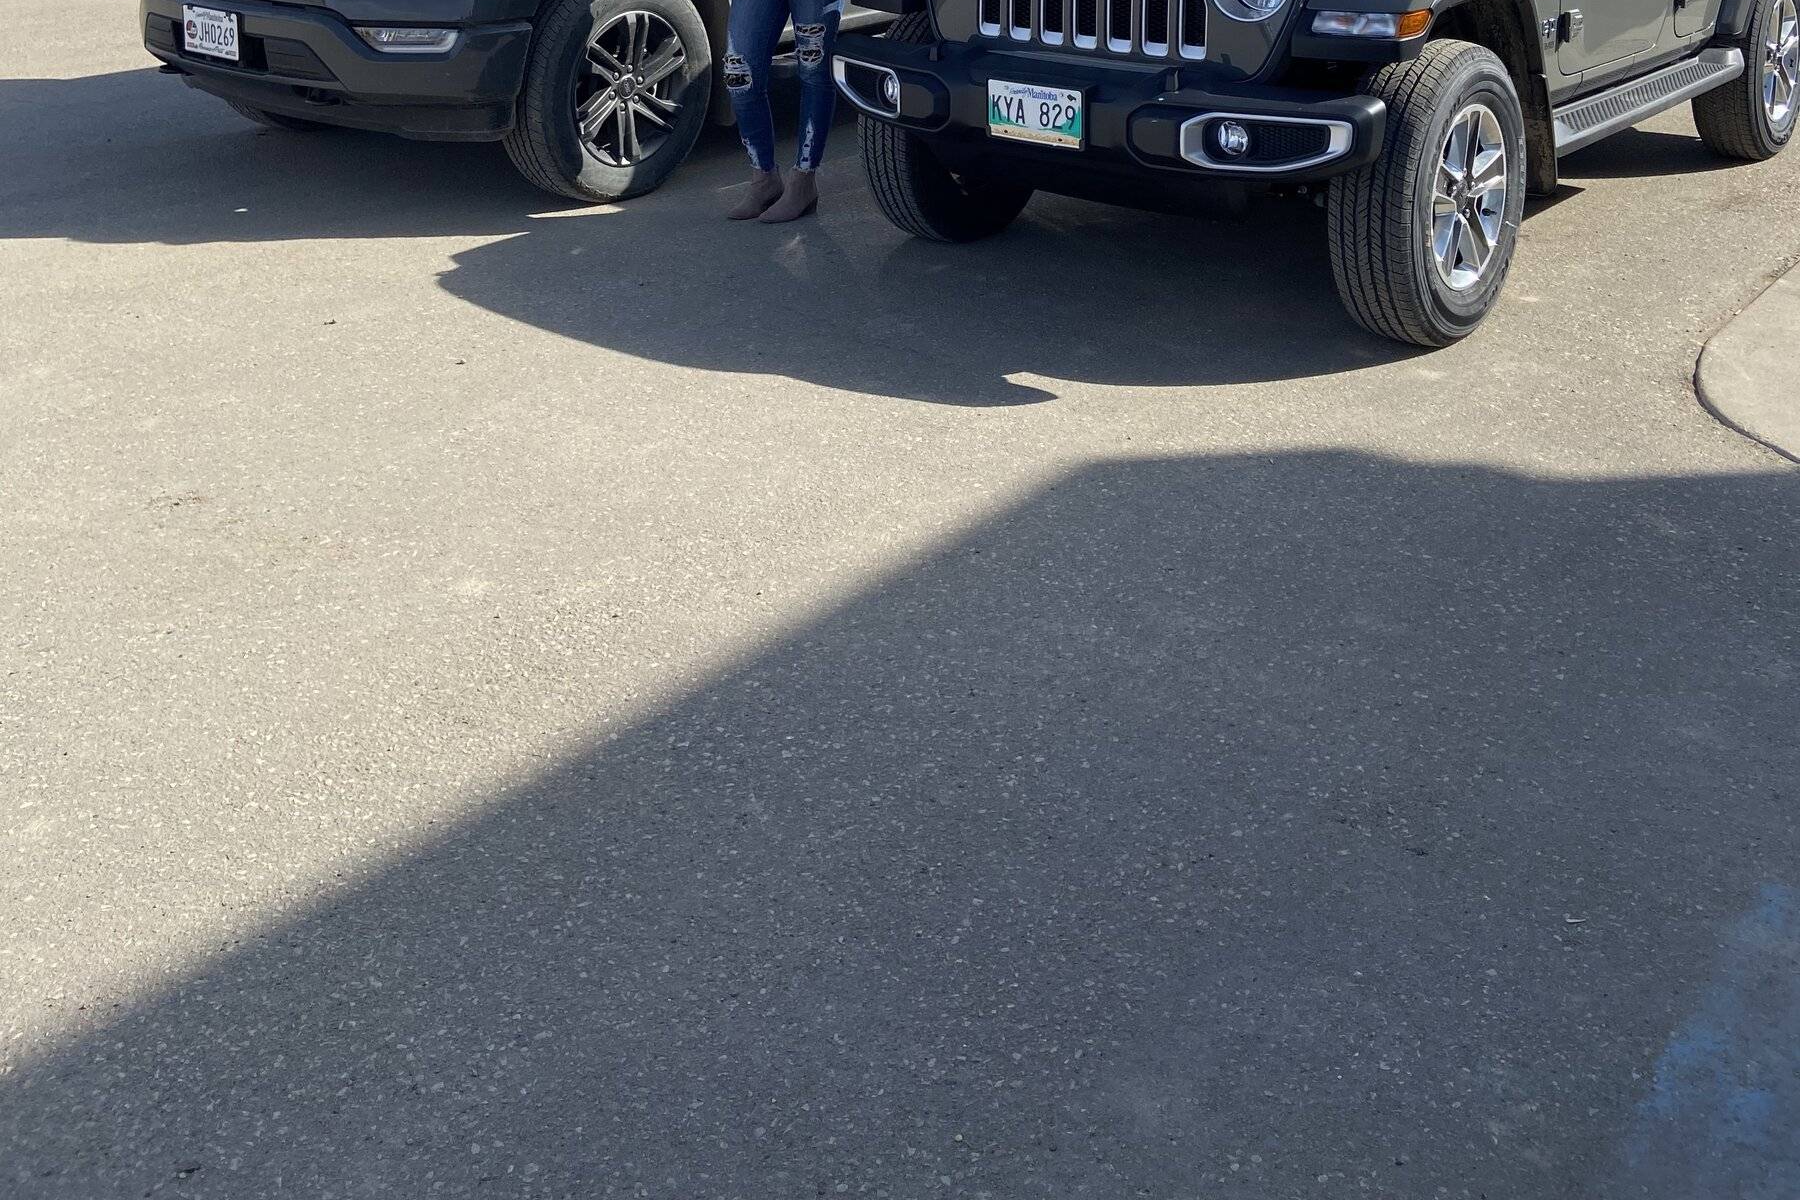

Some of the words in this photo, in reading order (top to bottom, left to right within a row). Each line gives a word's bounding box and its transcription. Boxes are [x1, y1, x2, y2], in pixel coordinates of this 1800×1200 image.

[199, 21, 235, 47] JH0269
[1027, 87, 1058, 102] Manitoba
[991, 94, 1026, 125] KYA
[1040, 101, 1076, 131] 829
